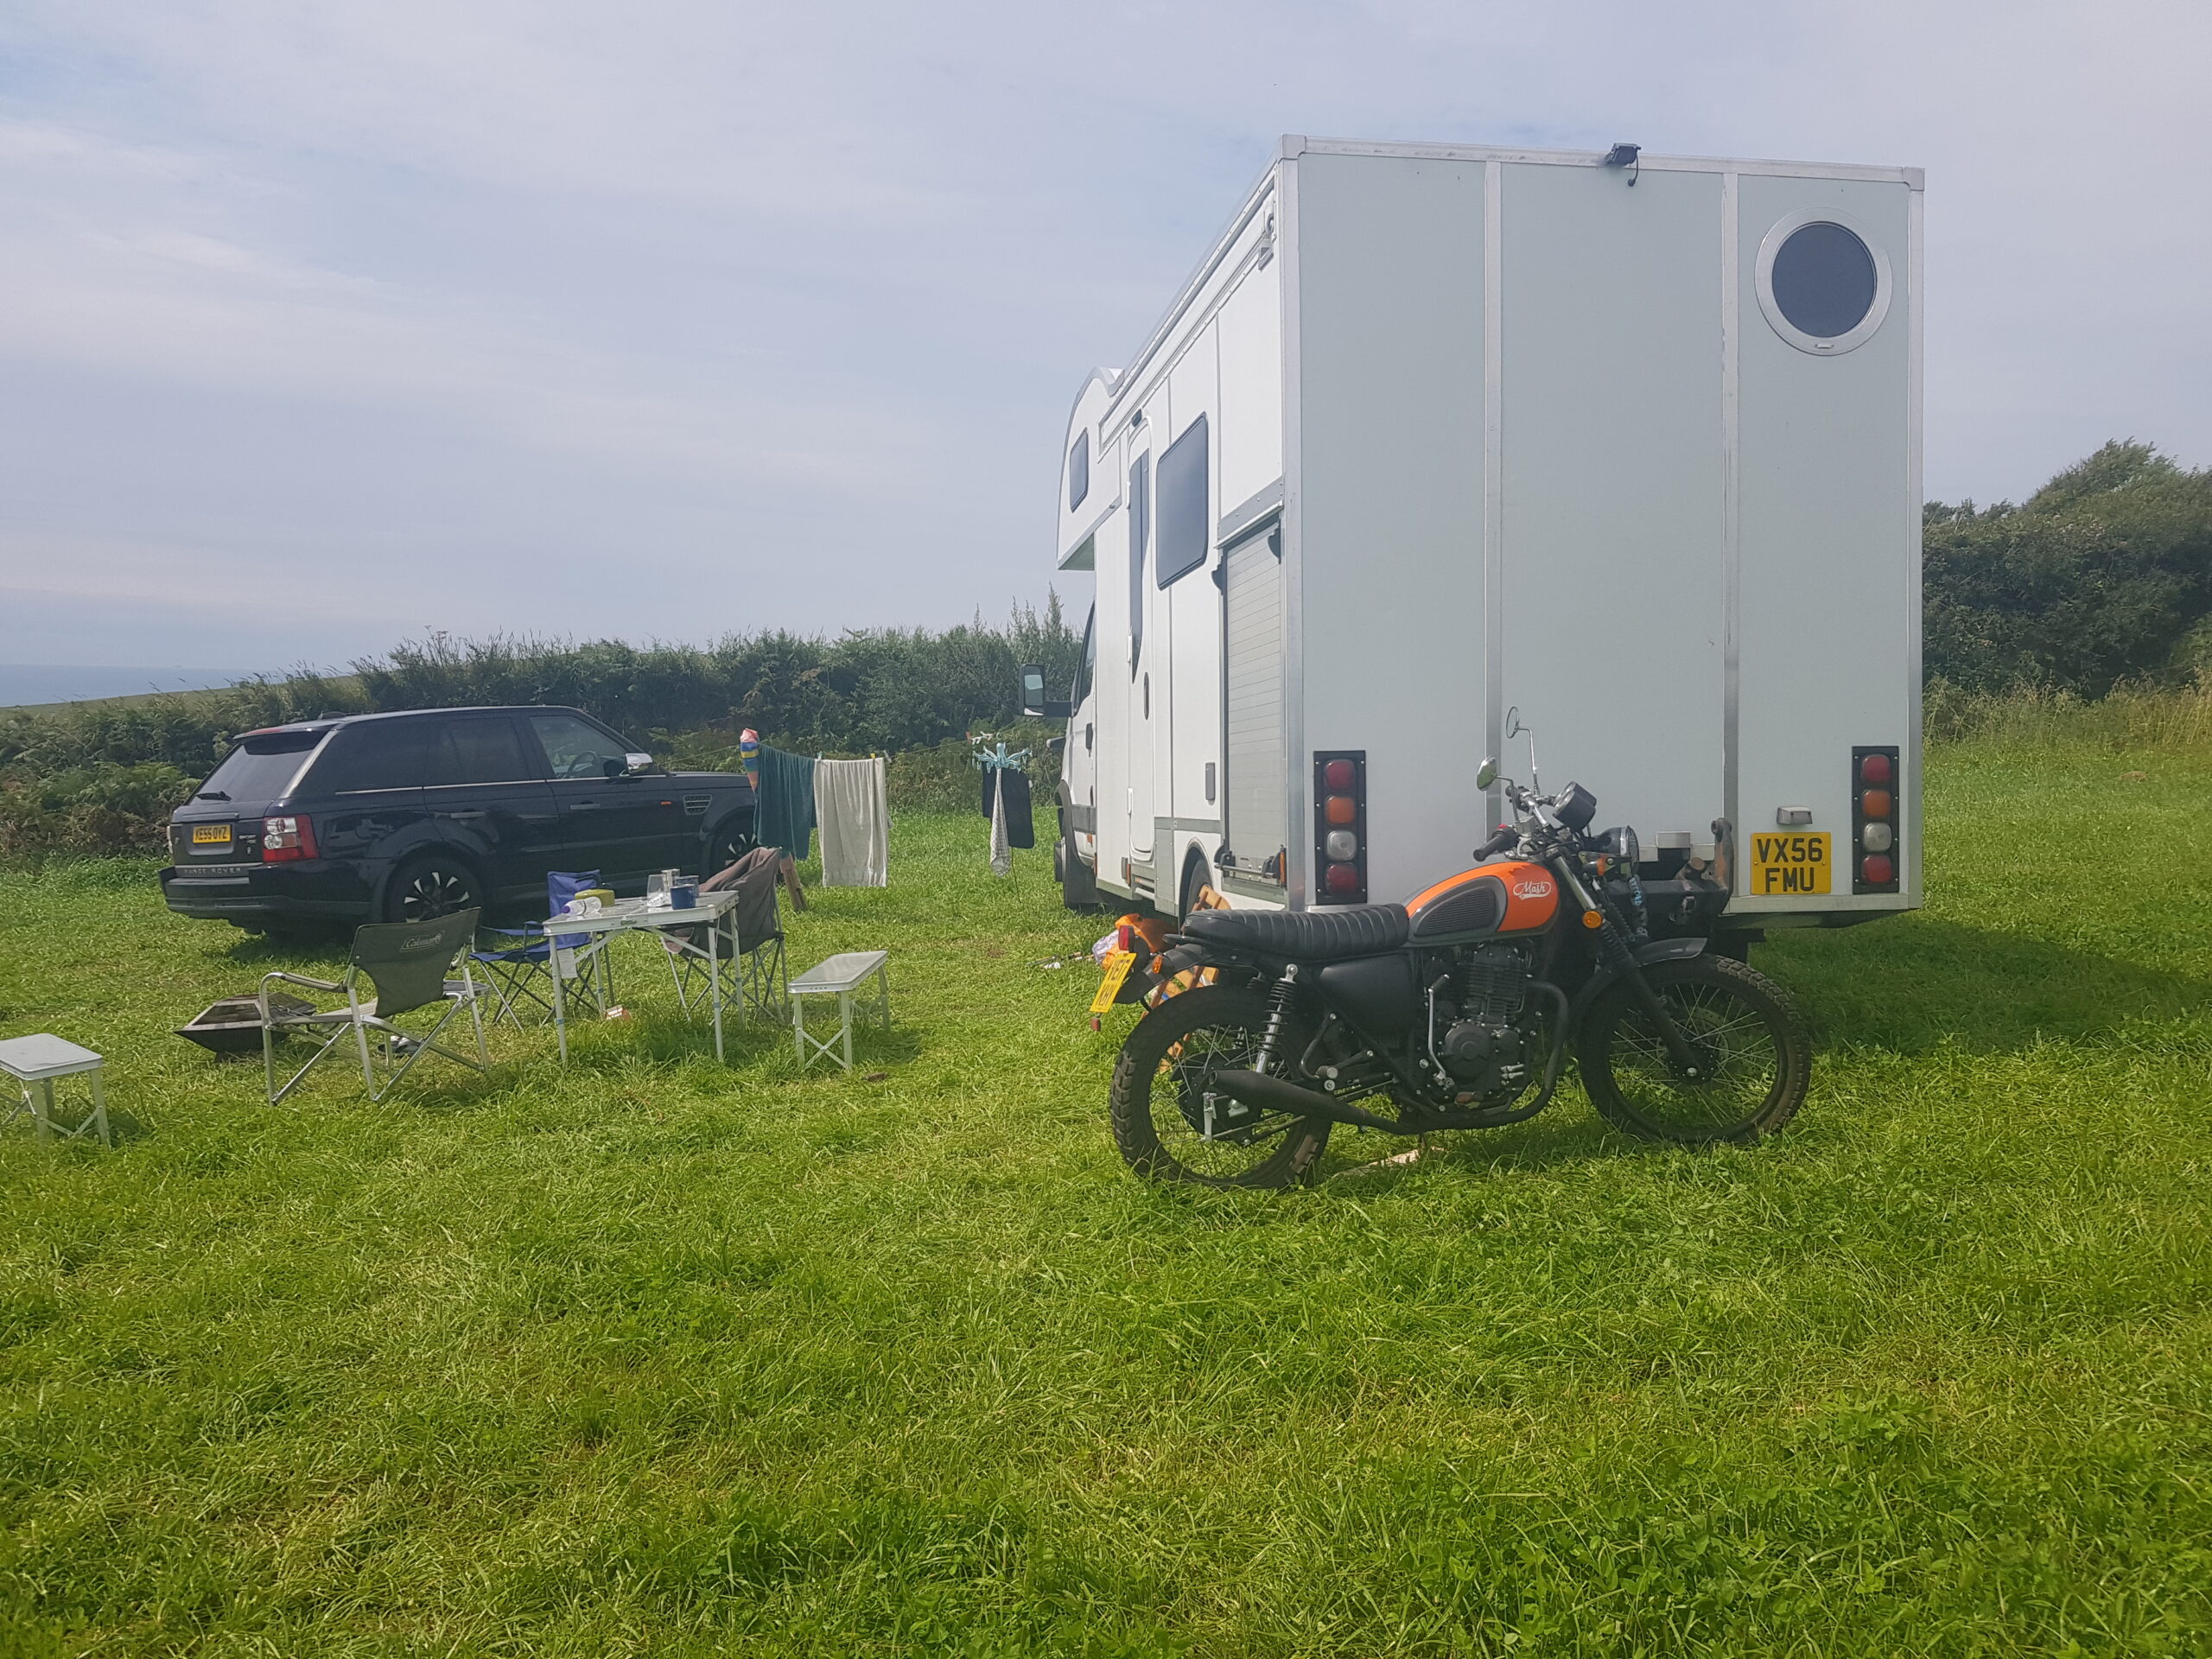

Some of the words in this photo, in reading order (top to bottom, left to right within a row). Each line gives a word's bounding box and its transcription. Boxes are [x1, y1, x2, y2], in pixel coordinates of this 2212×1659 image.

[1757, 837, 1823, 863] VX56
[1514, 880, 1551, 897] Mash
[1765, 867, 1815, 893] FMU
